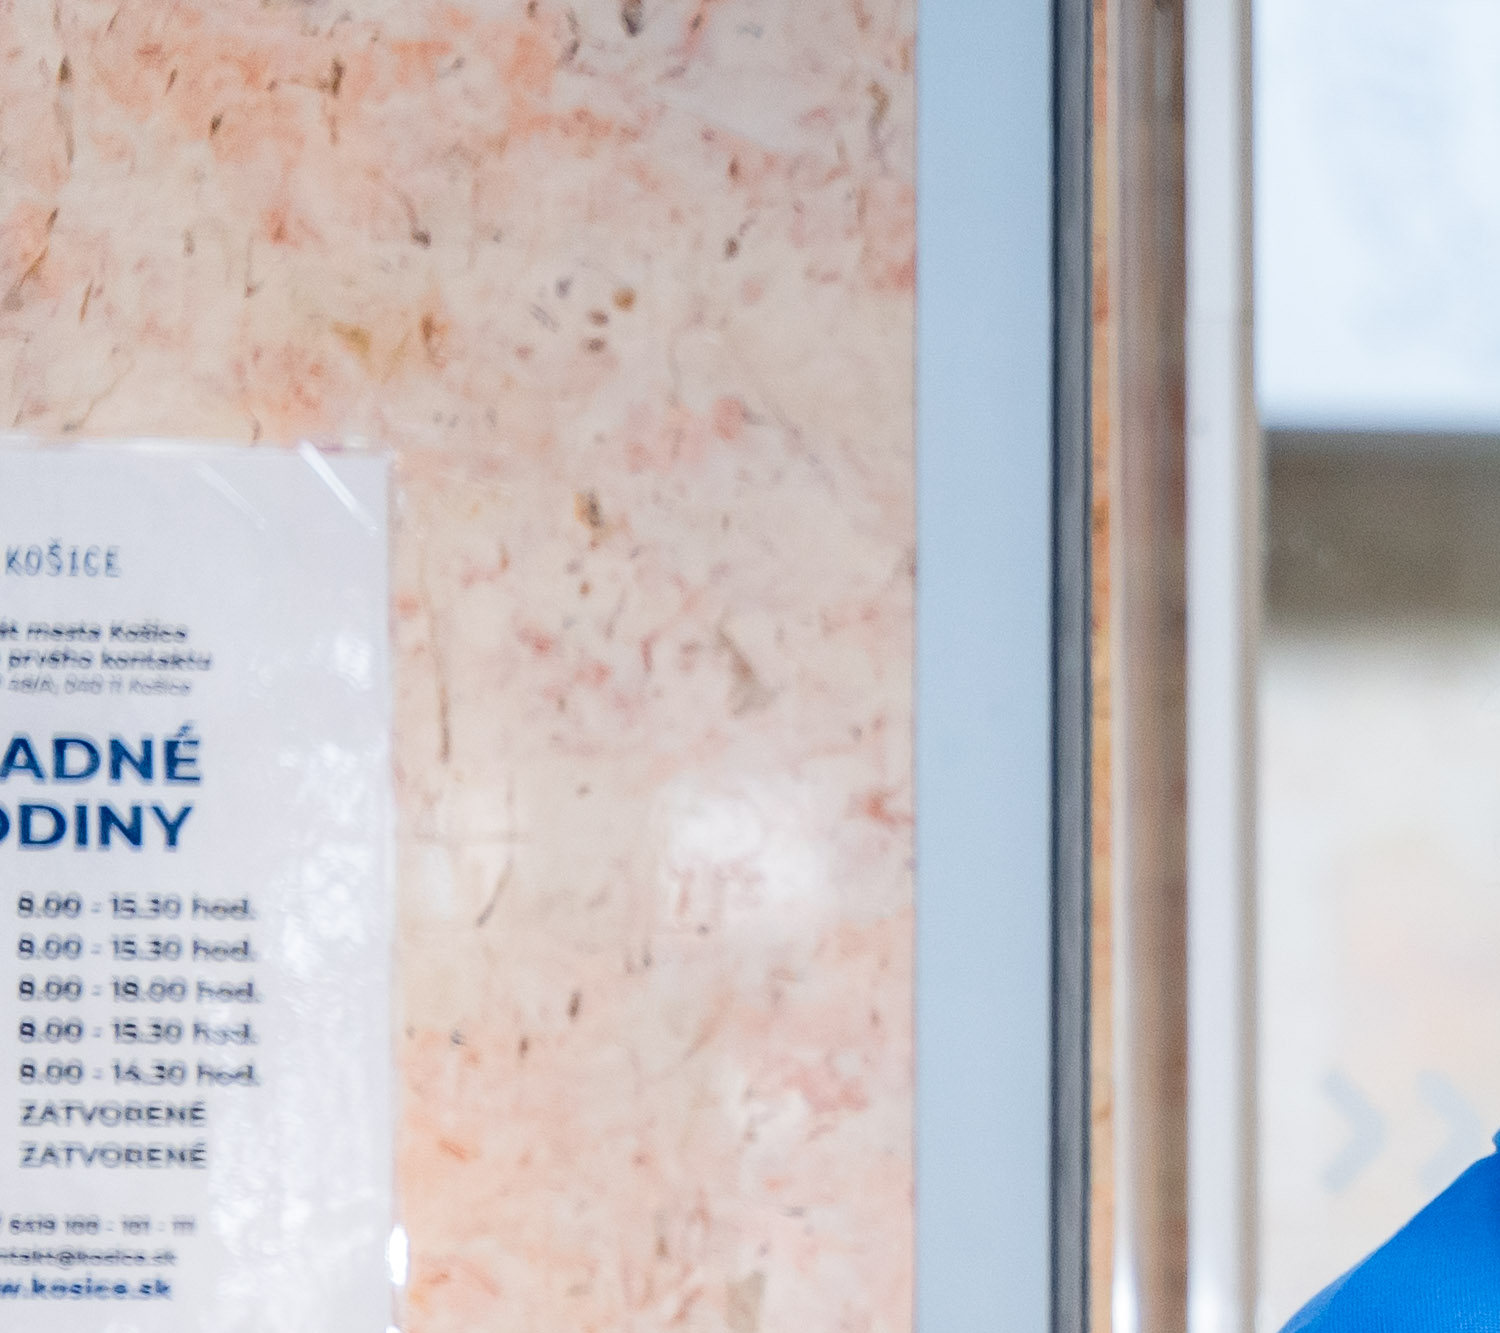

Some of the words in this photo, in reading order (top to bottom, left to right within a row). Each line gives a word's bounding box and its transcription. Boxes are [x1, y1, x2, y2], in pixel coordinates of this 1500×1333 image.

[5, 537, 121, 577] KOŠICE
[0, 720, 201, 783] ADNÉ
[18, 1093, 208, 1127] ZATVORENÉ
[18, 1135, 208, 1169] ZATVORENÉ
